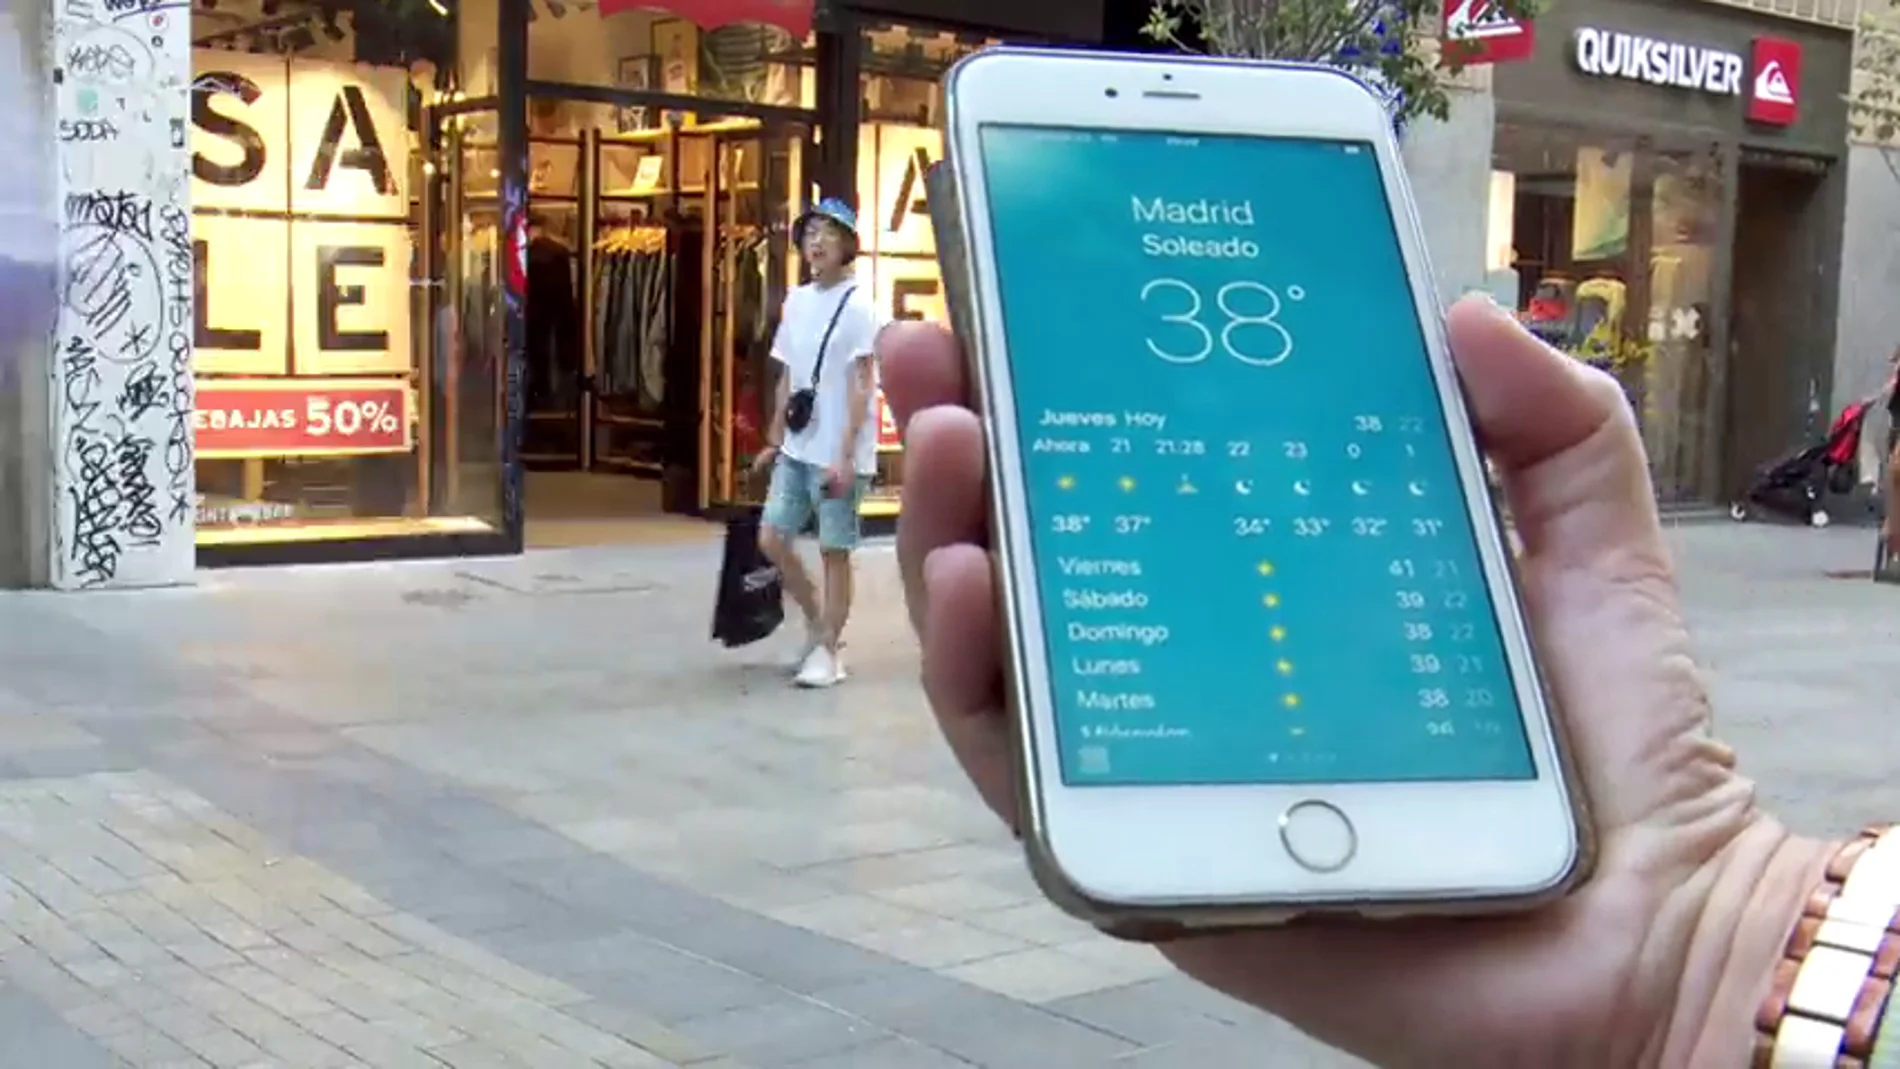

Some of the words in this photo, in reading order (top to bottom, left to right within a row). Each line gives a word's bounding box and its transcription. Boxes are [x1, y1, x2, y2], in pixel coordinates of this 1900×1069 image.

[1576, 27, 1742, 95] QUIKSILVER
[1131, 195, 1254, 226] Madrid
[1142, 232, 1260, 259] Soleado
[1140, 278, 1306, 367] 38°
[304, 394, 399, 437] 50%
[1039, 409, 1117, 427] Jueves
[1124, 410, 1168, 431] Hoy
[1032, 437, 1092, 453] Ahora
[1110, 438, 1132, 453] 21
[1346, 442, 1361, 459] 0
[1405, 443, 1416, 458] 1
[1115, 514, 1152, 534] 37°
[1057, 555, 1143, 576] Viernes
[1388, 558, 1415, 578] 41
[1062, 587, 1150, 610] Sábado
[1067, 621, 1170, 646] Domingo
[1072, 656, 1141, 676] Lunes
[1077, 689, 1156, 710] Martes
